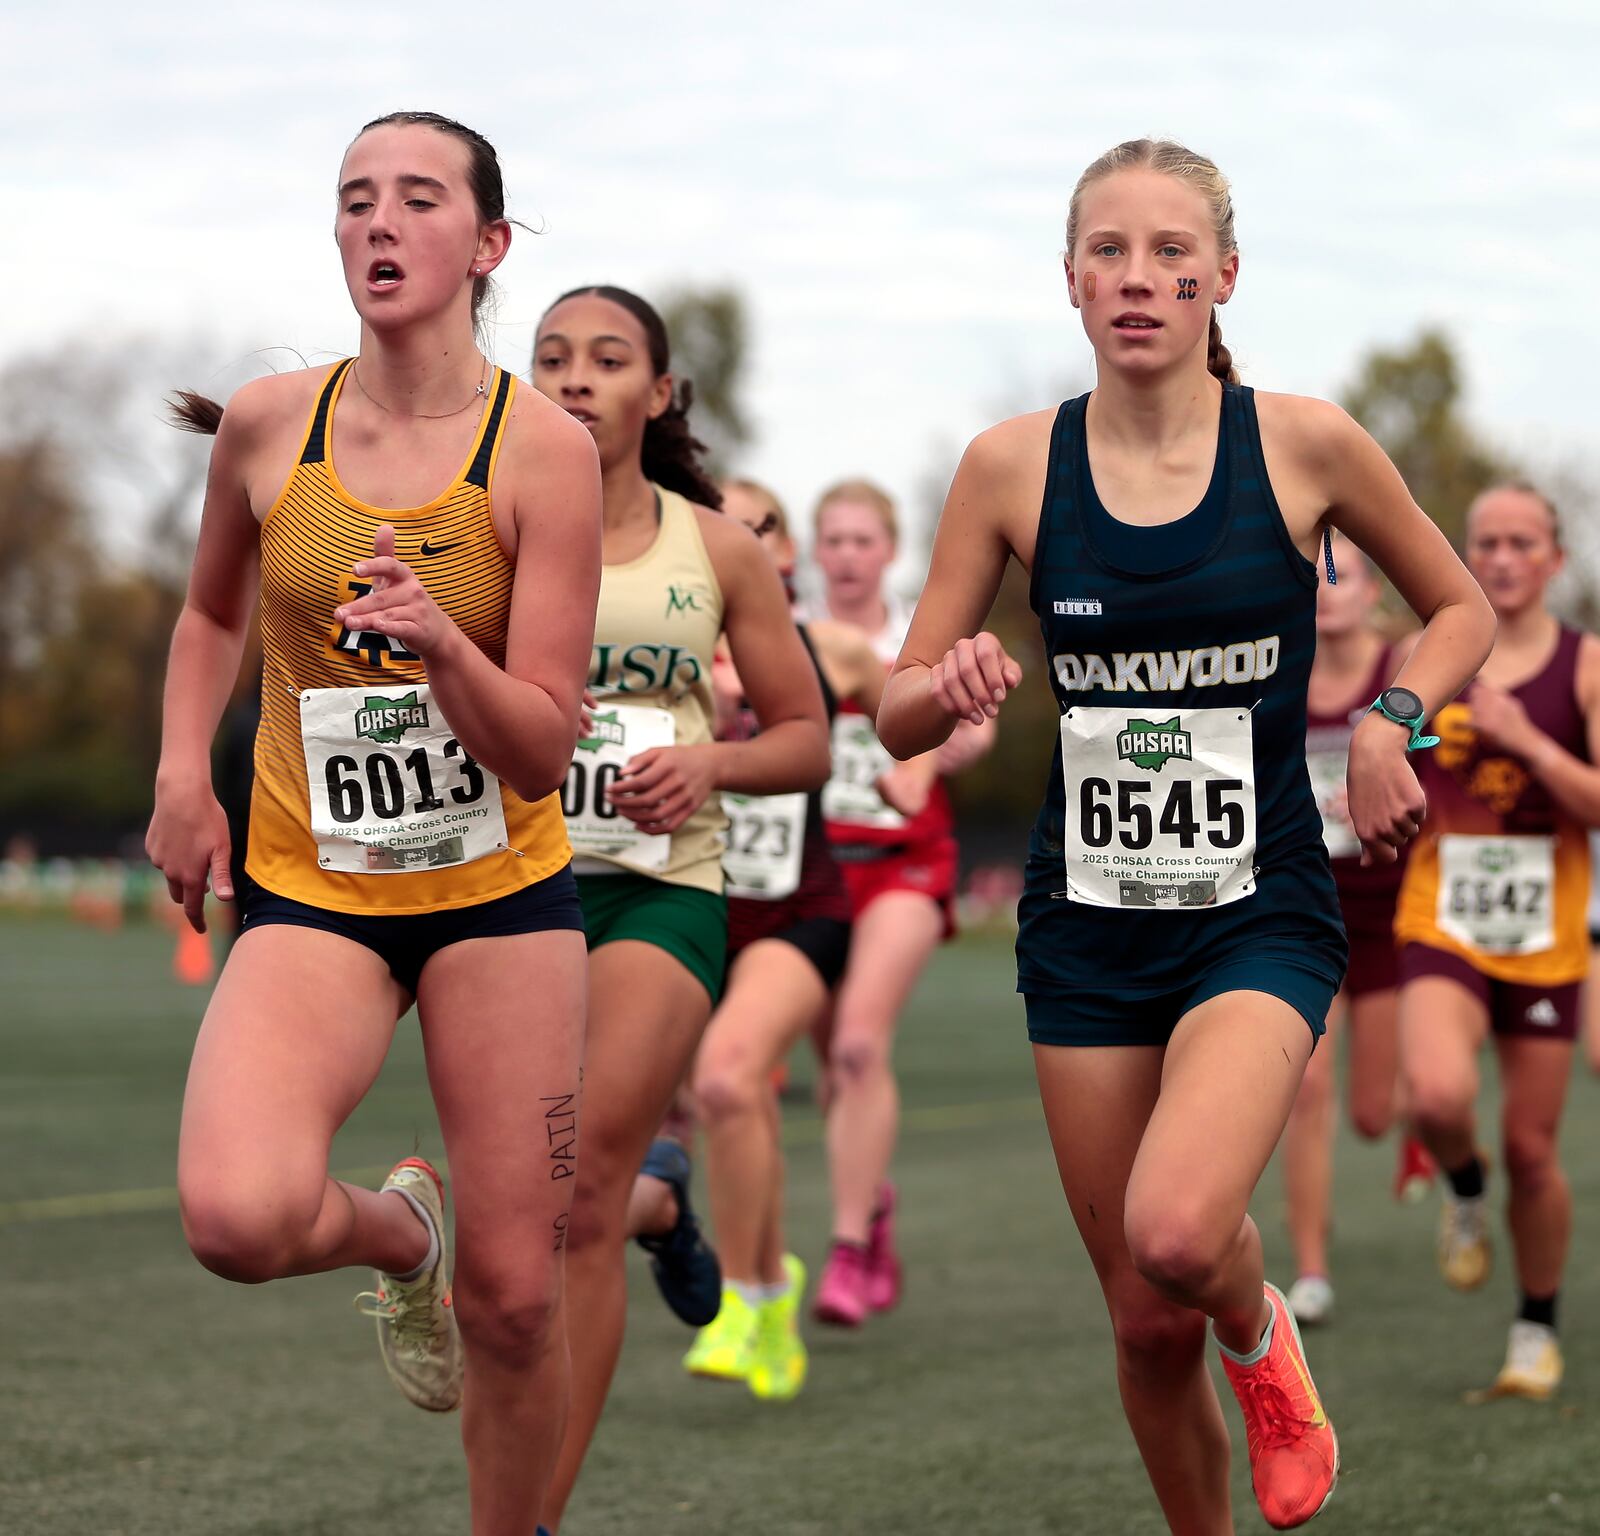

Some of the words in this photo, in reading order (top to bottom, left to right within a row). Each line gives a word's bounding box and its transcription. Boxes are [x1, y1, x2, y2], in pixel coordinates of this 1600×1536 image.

[1053, 635, 1280, 692] OAKWOOD
[358, 706, 426, 733] OHSAA
[1120, 732, 1190, 756] OHSAA
[325, 739, 485, 823] 6013
[330, 827, 359, 837] 2025
[363, 823, 405, 836] OHSAA
[409, 818, 441, 831] Cross
[443, 806, 489, 824] Country
[1080, 777, 1245, 850] 6545
[389, 824, 470, 847] Championship
[1082, 854, 1109, 864] 2025
[1112, 855, 1153, 866] OHSAA
[1156, 856, 1191, 866] Cross
[1194, 855, 1242, 867] Country
[1103, 868, 1132, 879] State
[1136, 869, 1220, 881] Championship
[539, 1093, 576, 1181] PAIN
